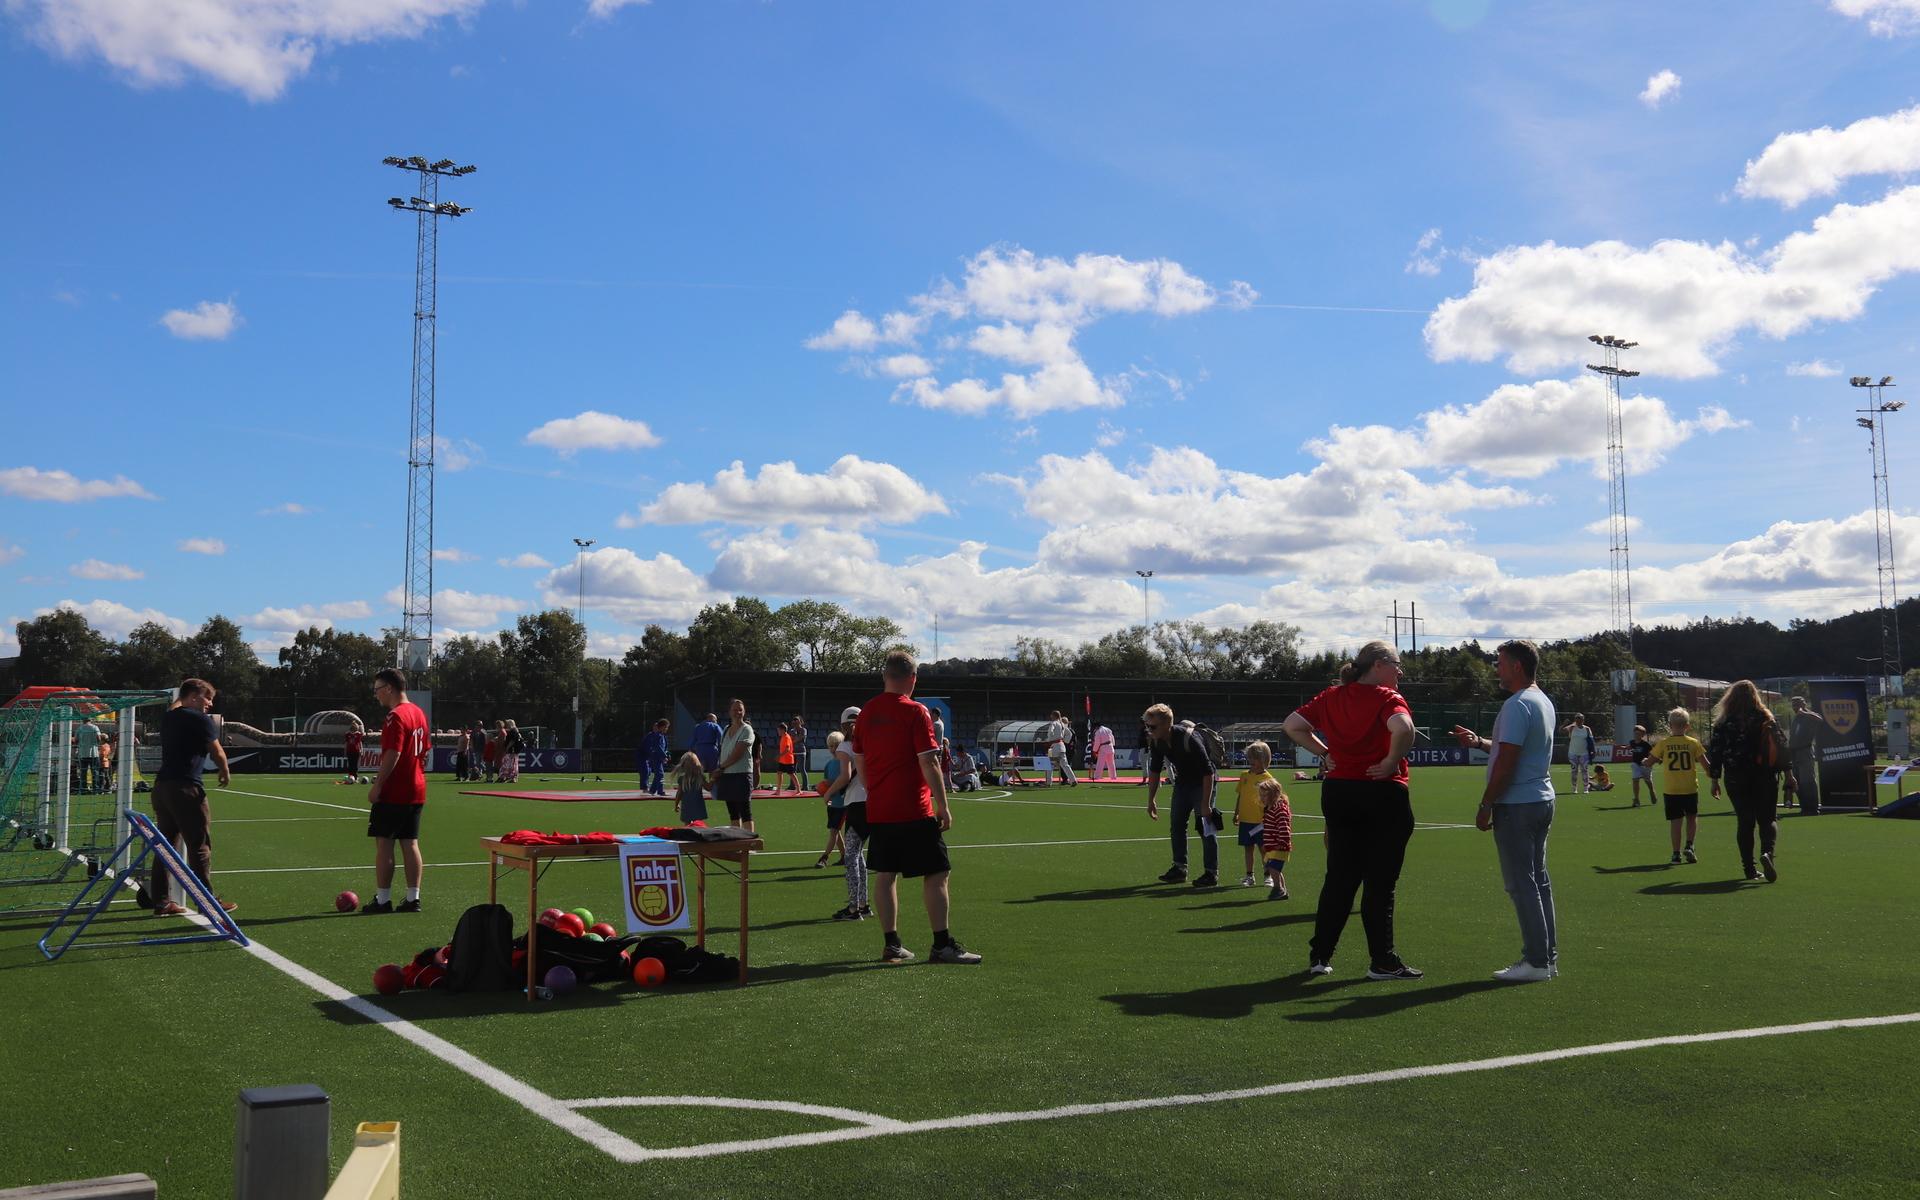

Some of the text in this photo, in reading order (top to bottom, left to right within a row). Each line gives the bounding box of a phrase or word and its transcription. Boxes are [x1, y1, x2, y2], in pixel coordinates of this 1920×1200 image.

[412, 727, 425, 756] 13
[279, 753, 349, 769] stadium
[1408, 750, 1448, 762] JITEX
[1668, 751, 1692, 771] 20
